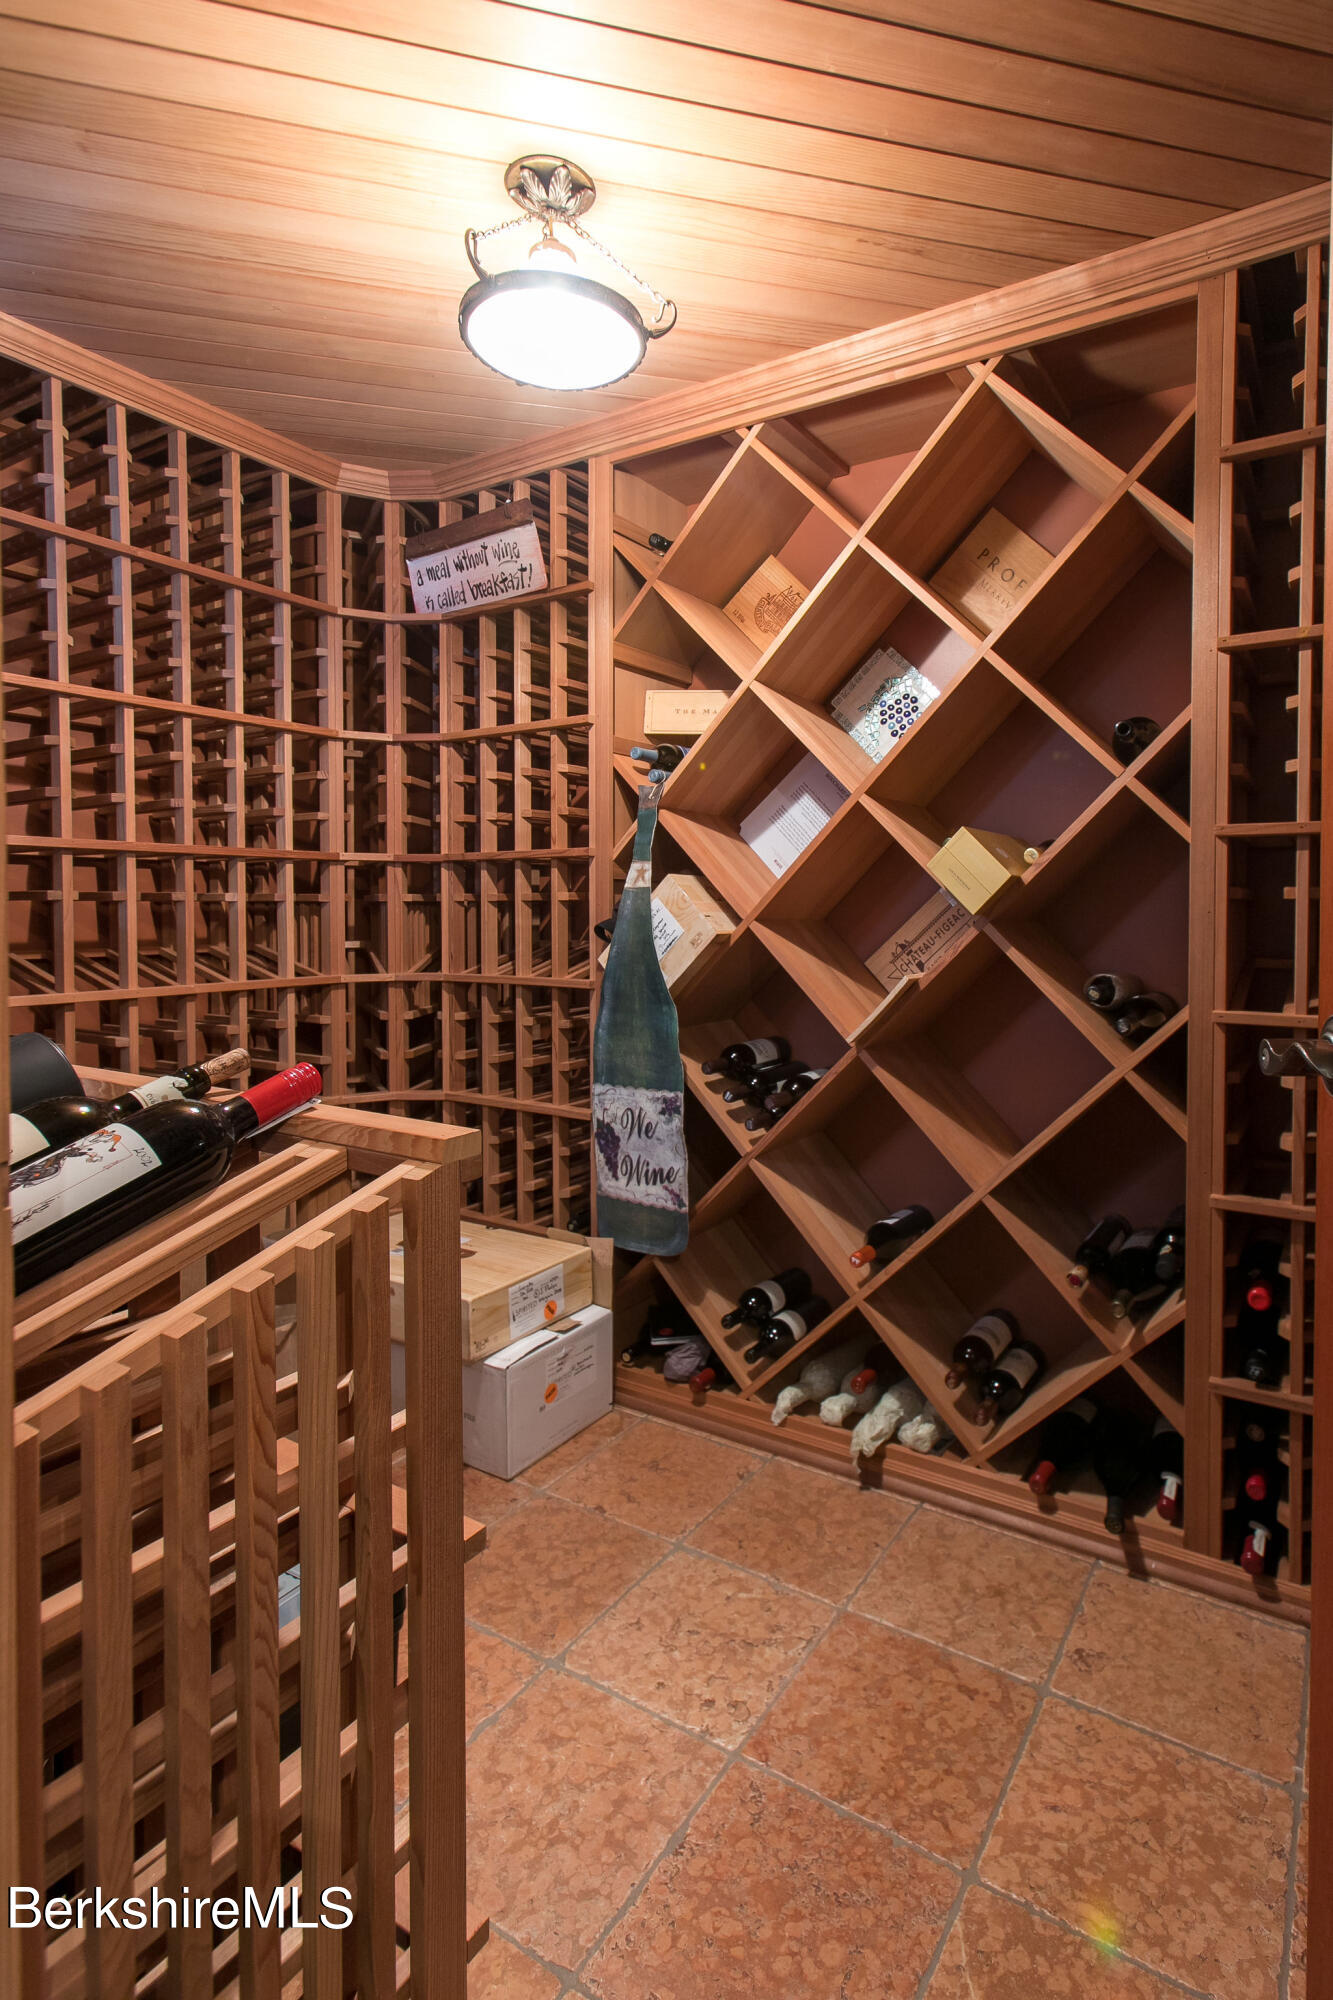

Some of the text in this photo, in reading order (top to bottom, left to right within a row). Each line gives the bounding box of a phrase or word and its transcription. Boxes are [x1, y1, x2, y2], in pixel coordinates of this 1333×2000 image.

[416, 538, 520, 587] a meal without wine
[424, 562, 533, 611] is called breakfast!
[620, 1107, 658, 1144] We
[620, 1153, 680, 1187] Wine
